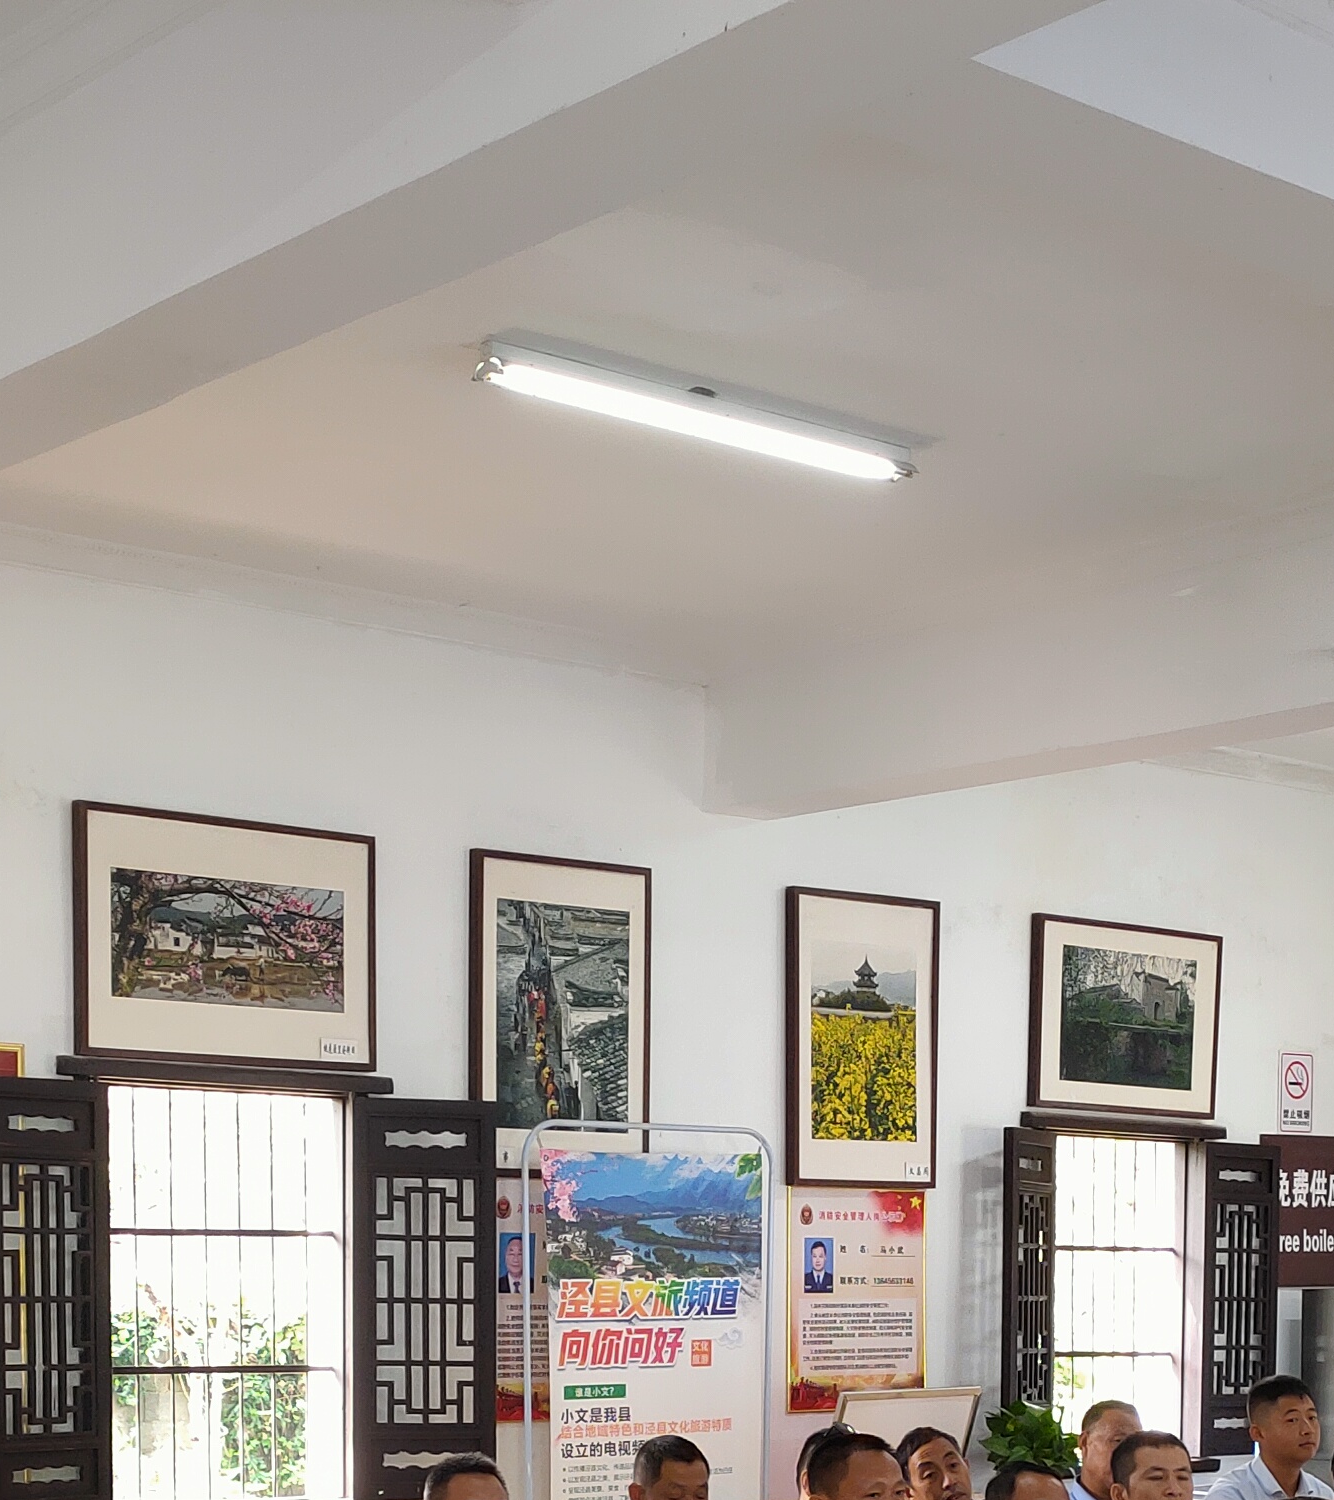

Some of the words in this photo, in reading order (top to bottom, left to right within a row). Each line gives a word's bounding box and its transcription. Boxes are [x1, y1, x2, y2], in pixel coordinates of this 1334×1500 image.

[1279, 1234, 1300, 1252] ree
[555, 1277, 742, 1321] 泾县文旅频道
[557, 1326, 685, 1370] 向你问好
[560, 1406, 631, 1424] 小文是我县
